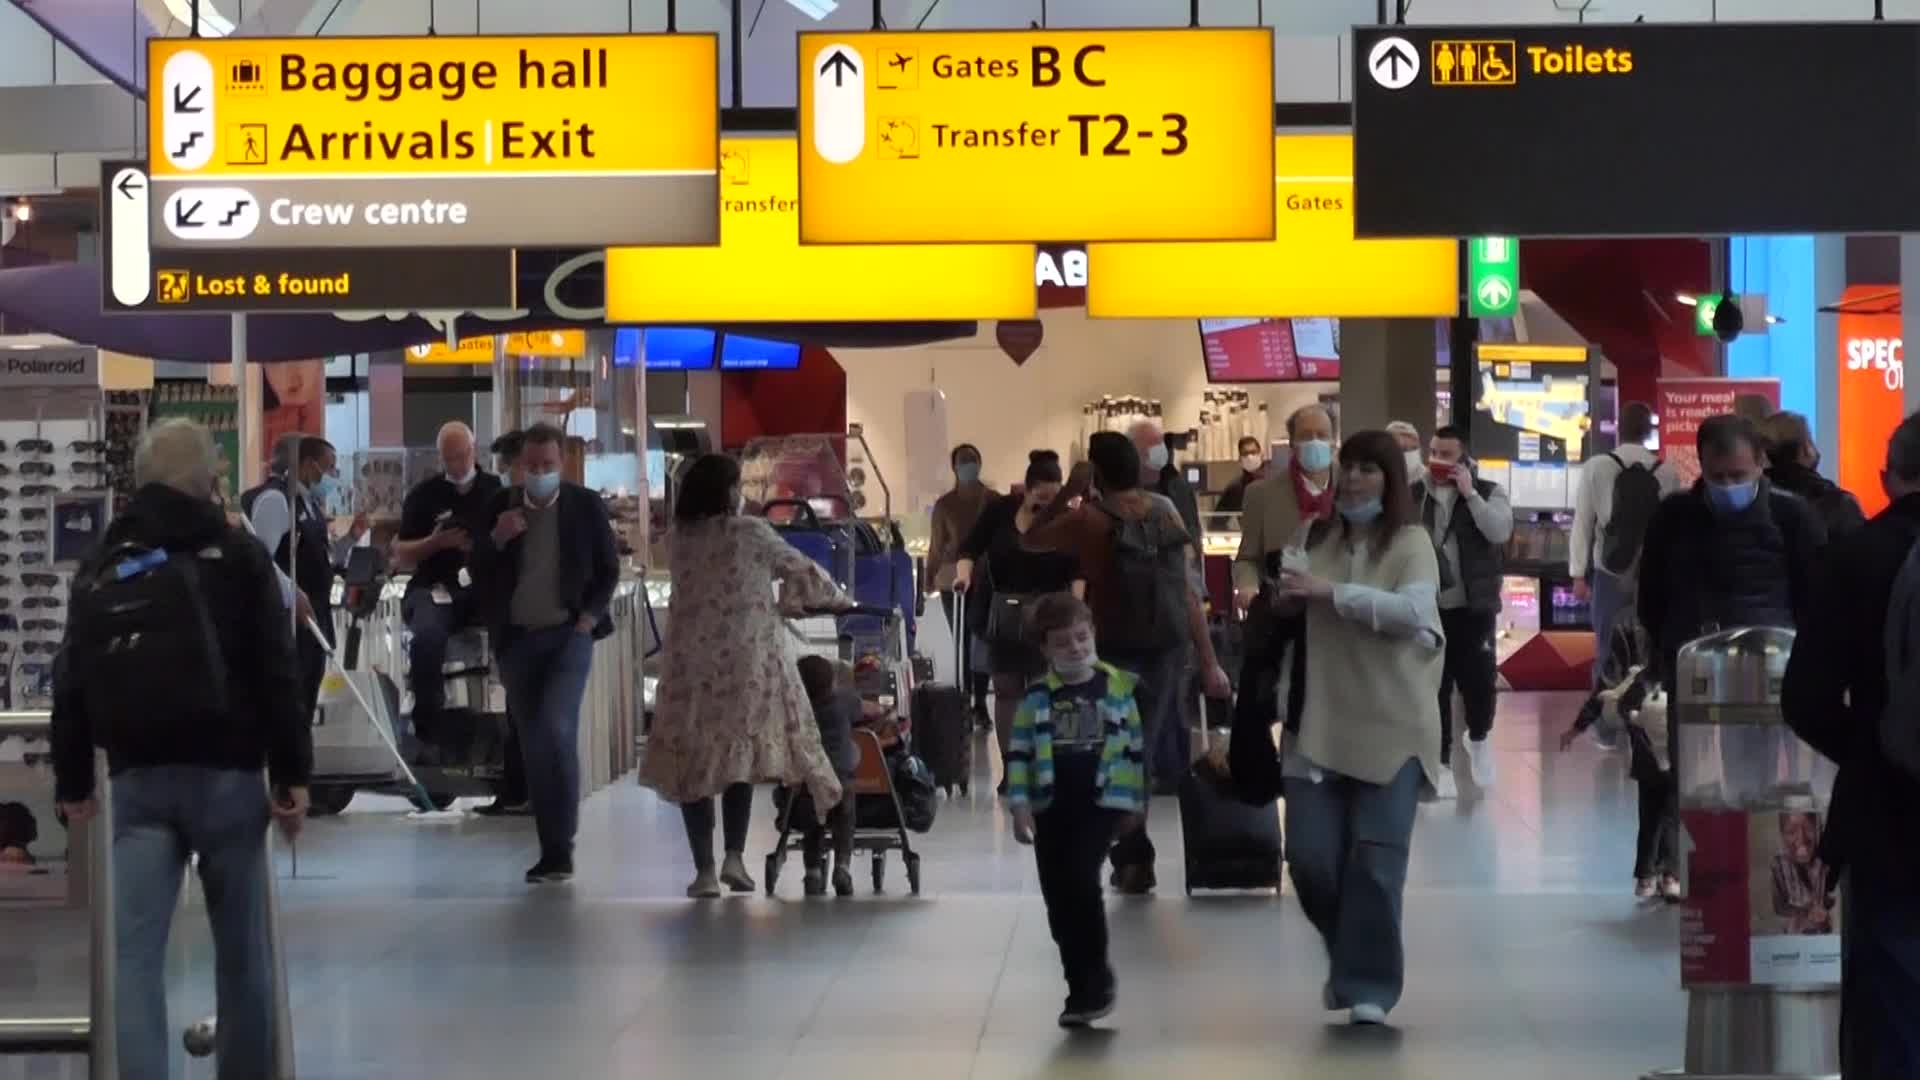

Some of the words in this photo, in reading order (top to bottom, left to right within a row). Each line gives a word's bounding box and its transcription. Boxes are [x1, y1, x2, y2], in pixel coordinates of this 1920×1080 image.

[932, 54, 1018, 79] Gates
[1031, 45, 1061, 87] B
[1073, 44, 1106, 87] C
[1527, 45, 1633, 74] Toilets
[281, 53, 496, 102] Baggage
[519, 48, 607, 89] hall
[280, 119, 475, 160] Arrivals
[502, 119, 595, 159] Exit
[932, 121, 1060, 148] Transfer
[1068, 113, 1188, 157] T2-3
[269, 197, 355, 225] Crew
[364, 198, 468, 226] centre
[722, 195, 797, 213] ransfer
[1286, 194, 1343, 210] Gates
[196, 275, 246, 295] Lost
[253, 275, 271, 295] &
[279, 273, 349, 295] found
[7, 356, 86, 375] Polaroid
[1665, 391, 1698, 404] Your
[1702, 390, 1735, 404] meal
